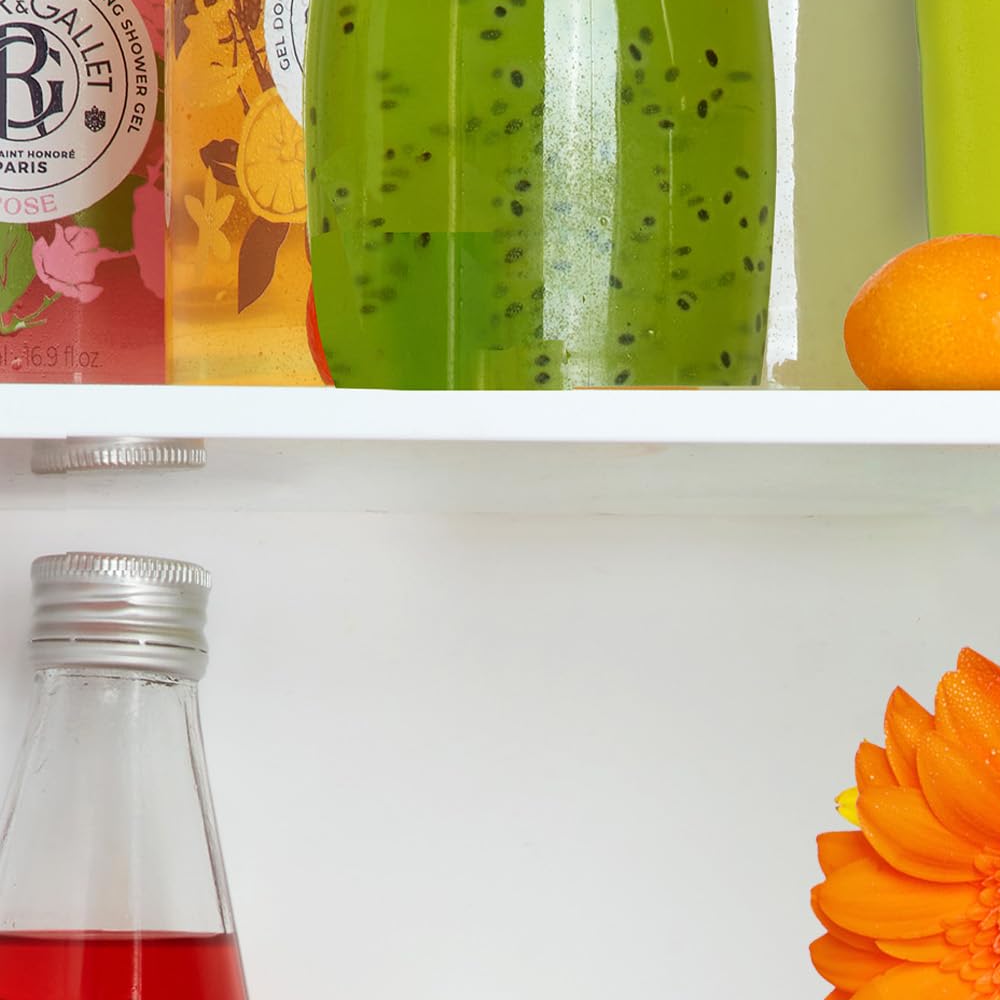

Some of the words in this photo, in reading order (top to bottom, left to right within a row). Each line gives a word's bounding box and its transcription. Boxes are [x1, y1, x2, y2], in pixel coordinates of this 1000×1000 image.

[121, 18, 148, 96] SHOWER
[275, 35, 291, 71] GEL
[127, 102, 146, 134] GEL
[27, 148, 76, 160] HONORÉ
[0, 192, 59, 216] OSE
